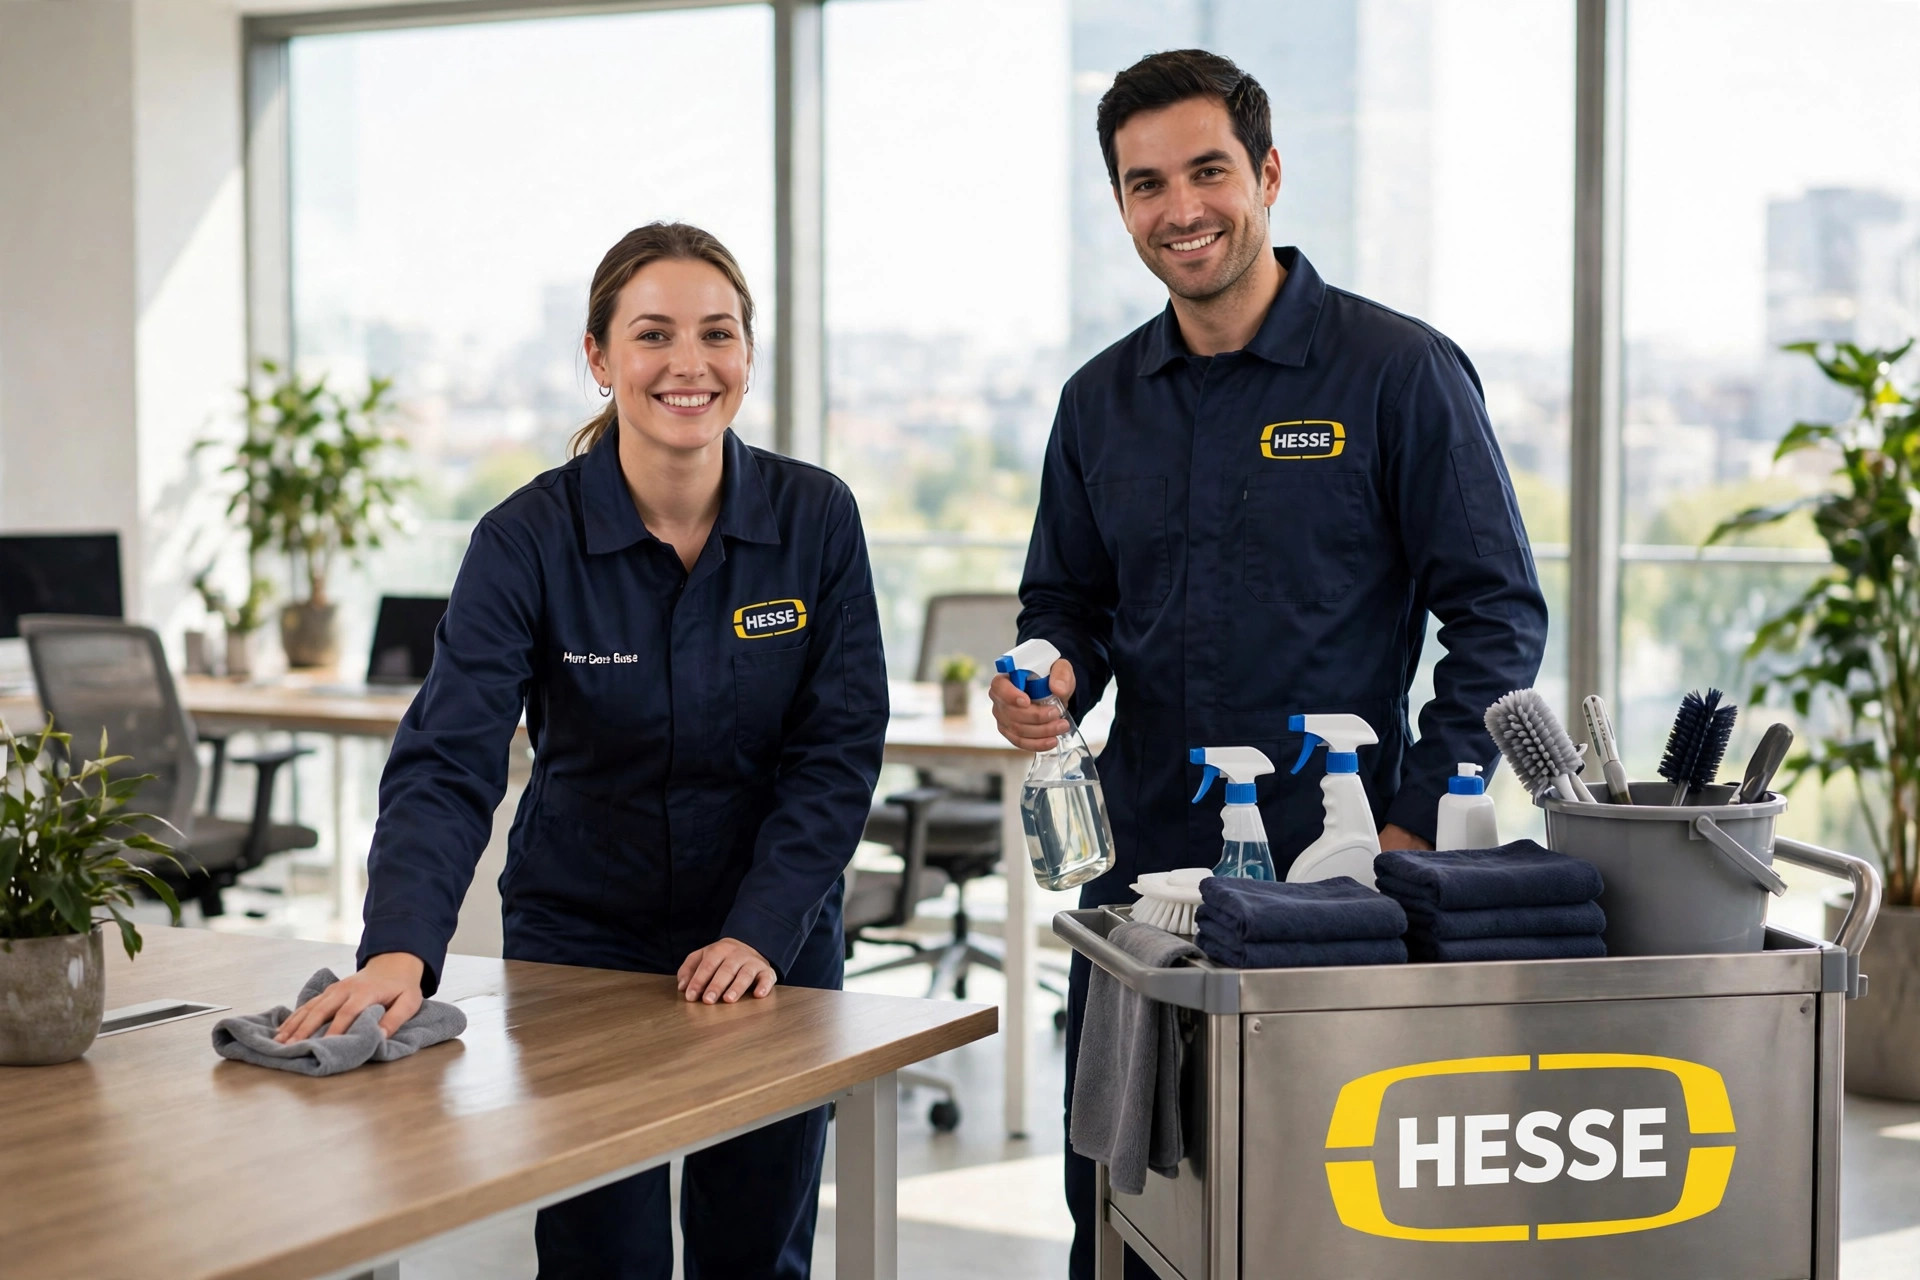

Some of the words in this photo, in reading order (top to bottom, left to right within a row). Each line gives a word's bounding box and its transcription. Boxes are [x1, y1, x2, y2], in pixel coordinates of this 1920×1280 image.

[1274, 432, 1331, 449] HESSE
[745, 609, 796, 630] HESSE
[1398, 1107, 1667, 1189] HESSE
